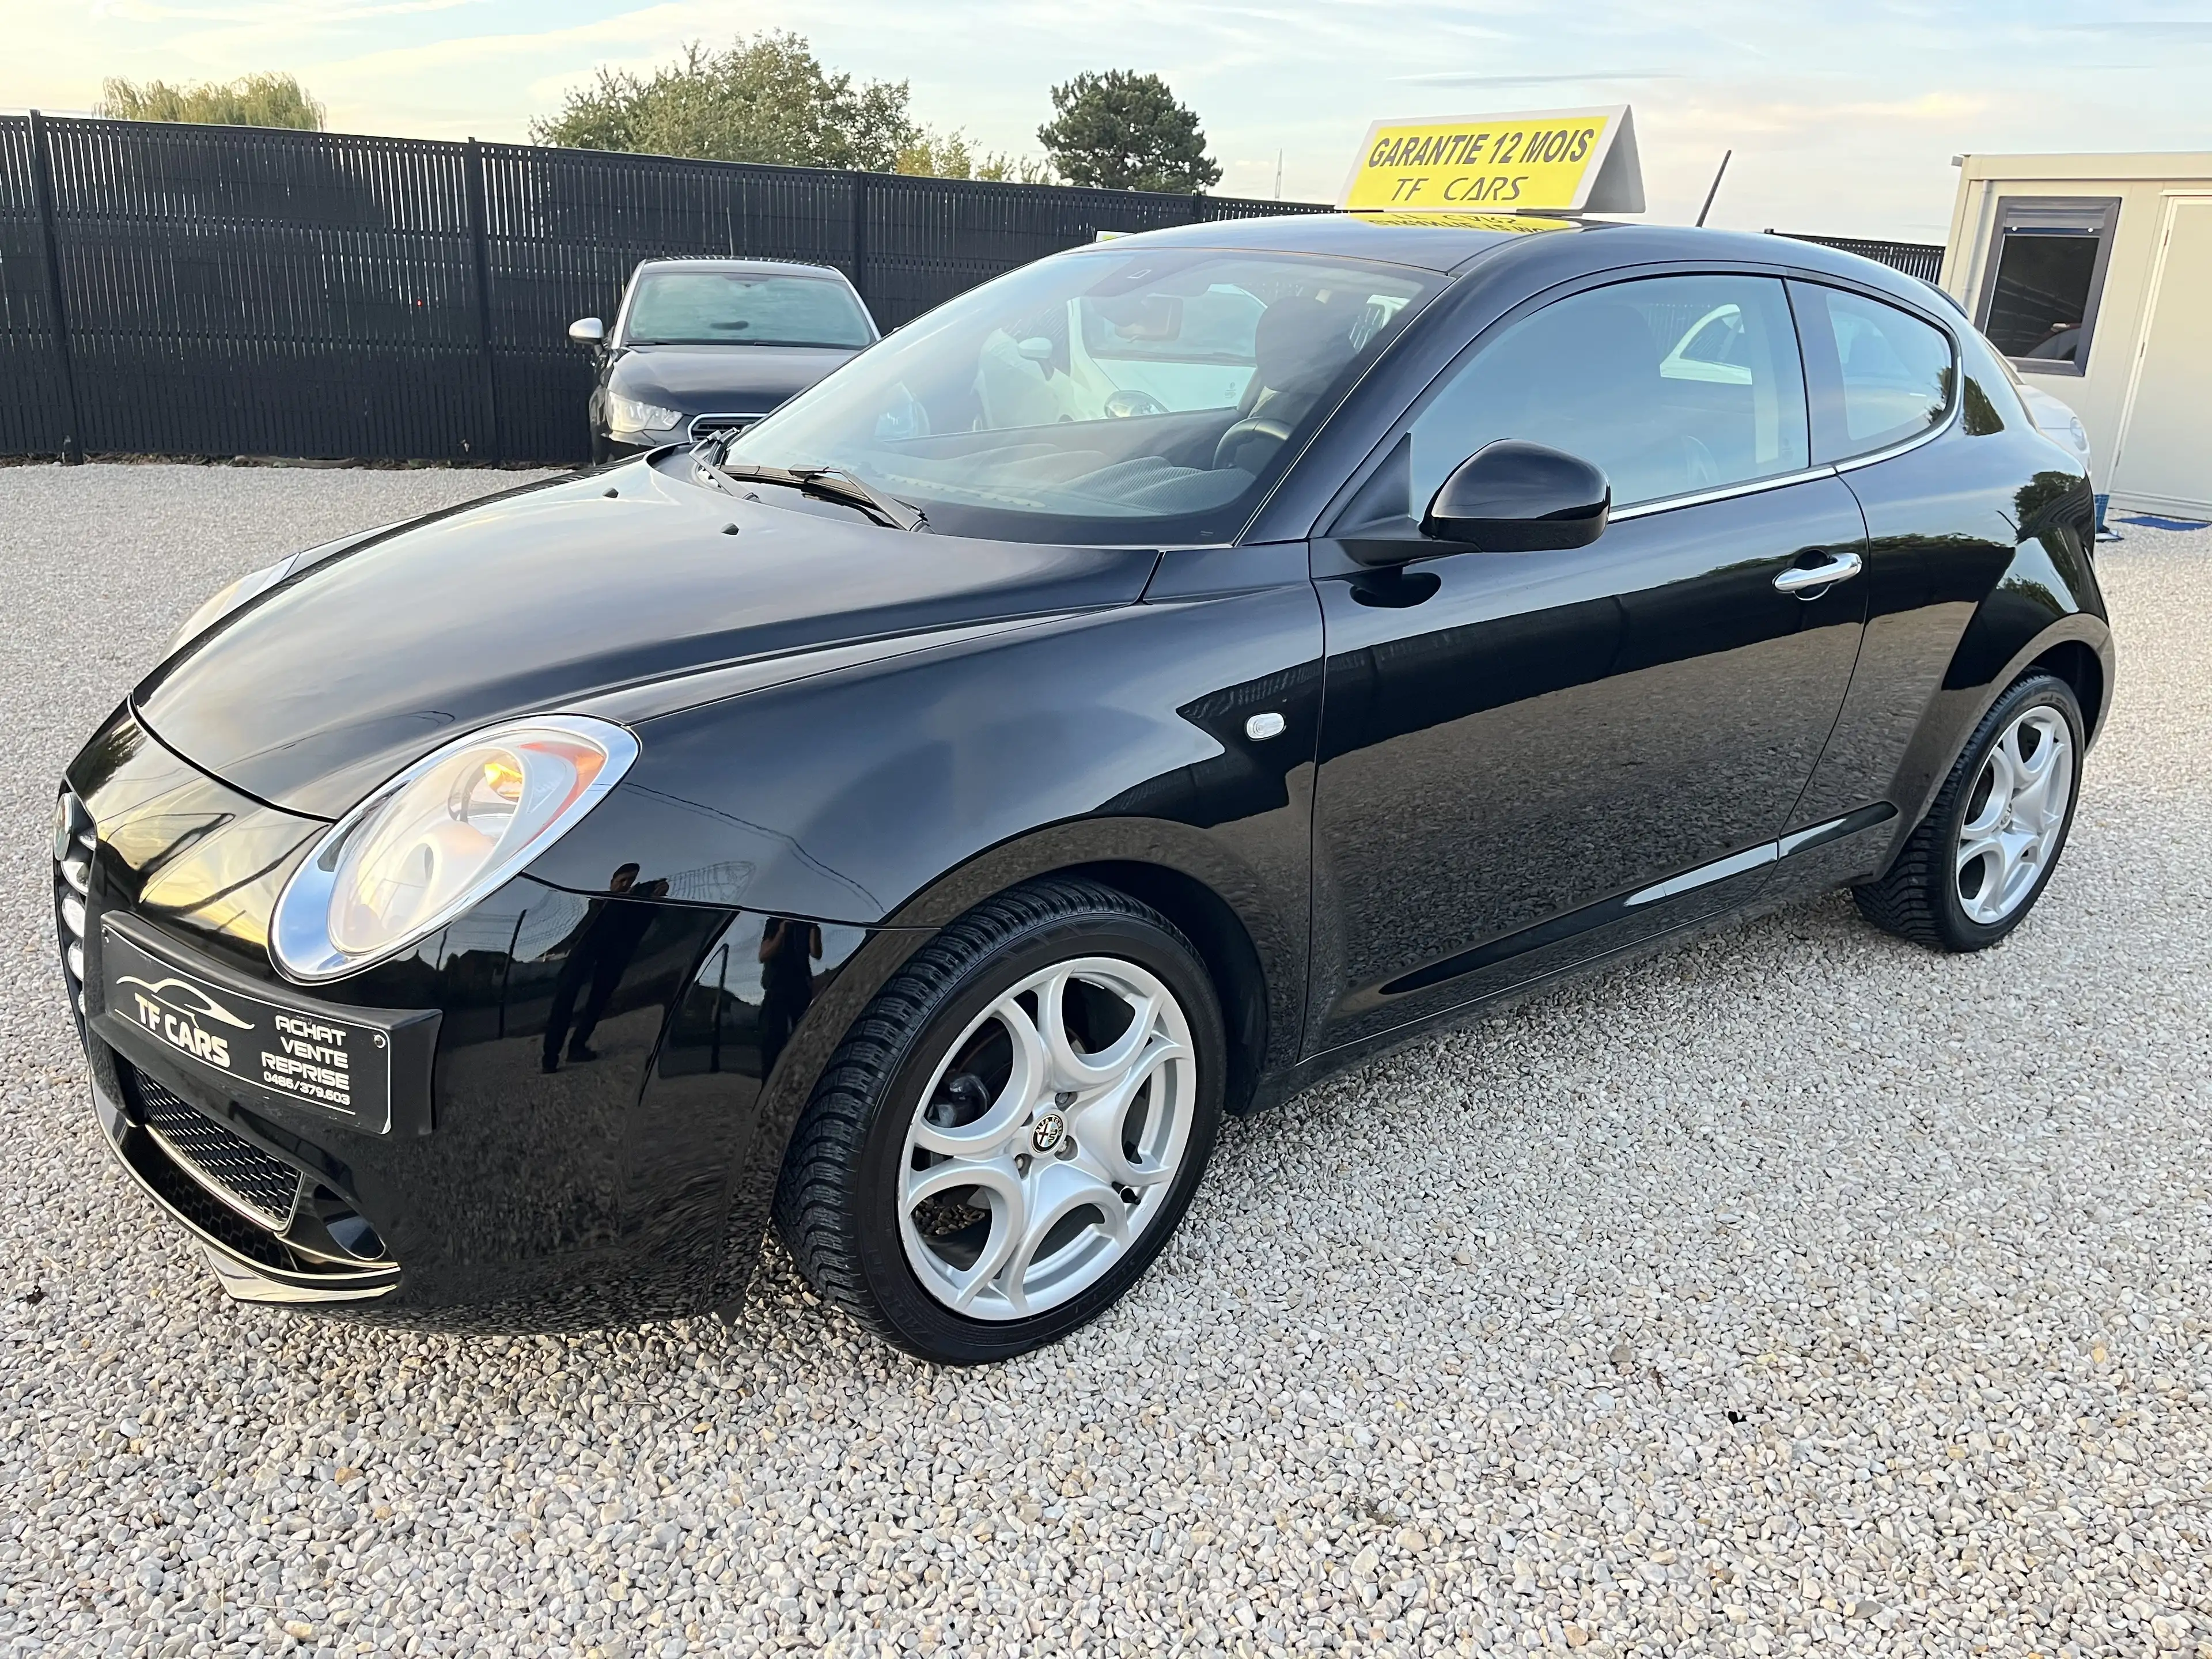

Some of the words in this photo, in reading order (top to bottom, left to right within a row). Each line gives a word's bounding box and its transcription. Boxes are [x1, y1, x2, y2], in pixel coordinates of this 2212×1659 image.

[1368, 134, 1489, 168] GARANTIE
[1488, 132, 1522, 164] 12
[1518, 128, 1594, 163] MOIS
[1391, 177, 1429, 202] TF
[1443, 176, 1529, 201] CARS
[134, 992, 161, 1031] TF
[165, 1013, 230, 1068] CARS
[275, 1015, 346, 1046] ACHAT
[280, 1036, 349, 1069] VENTE
[261, 1052, 350, 1090] REPRISE
[263, 1071, 350, 1105] 0486/379.603
